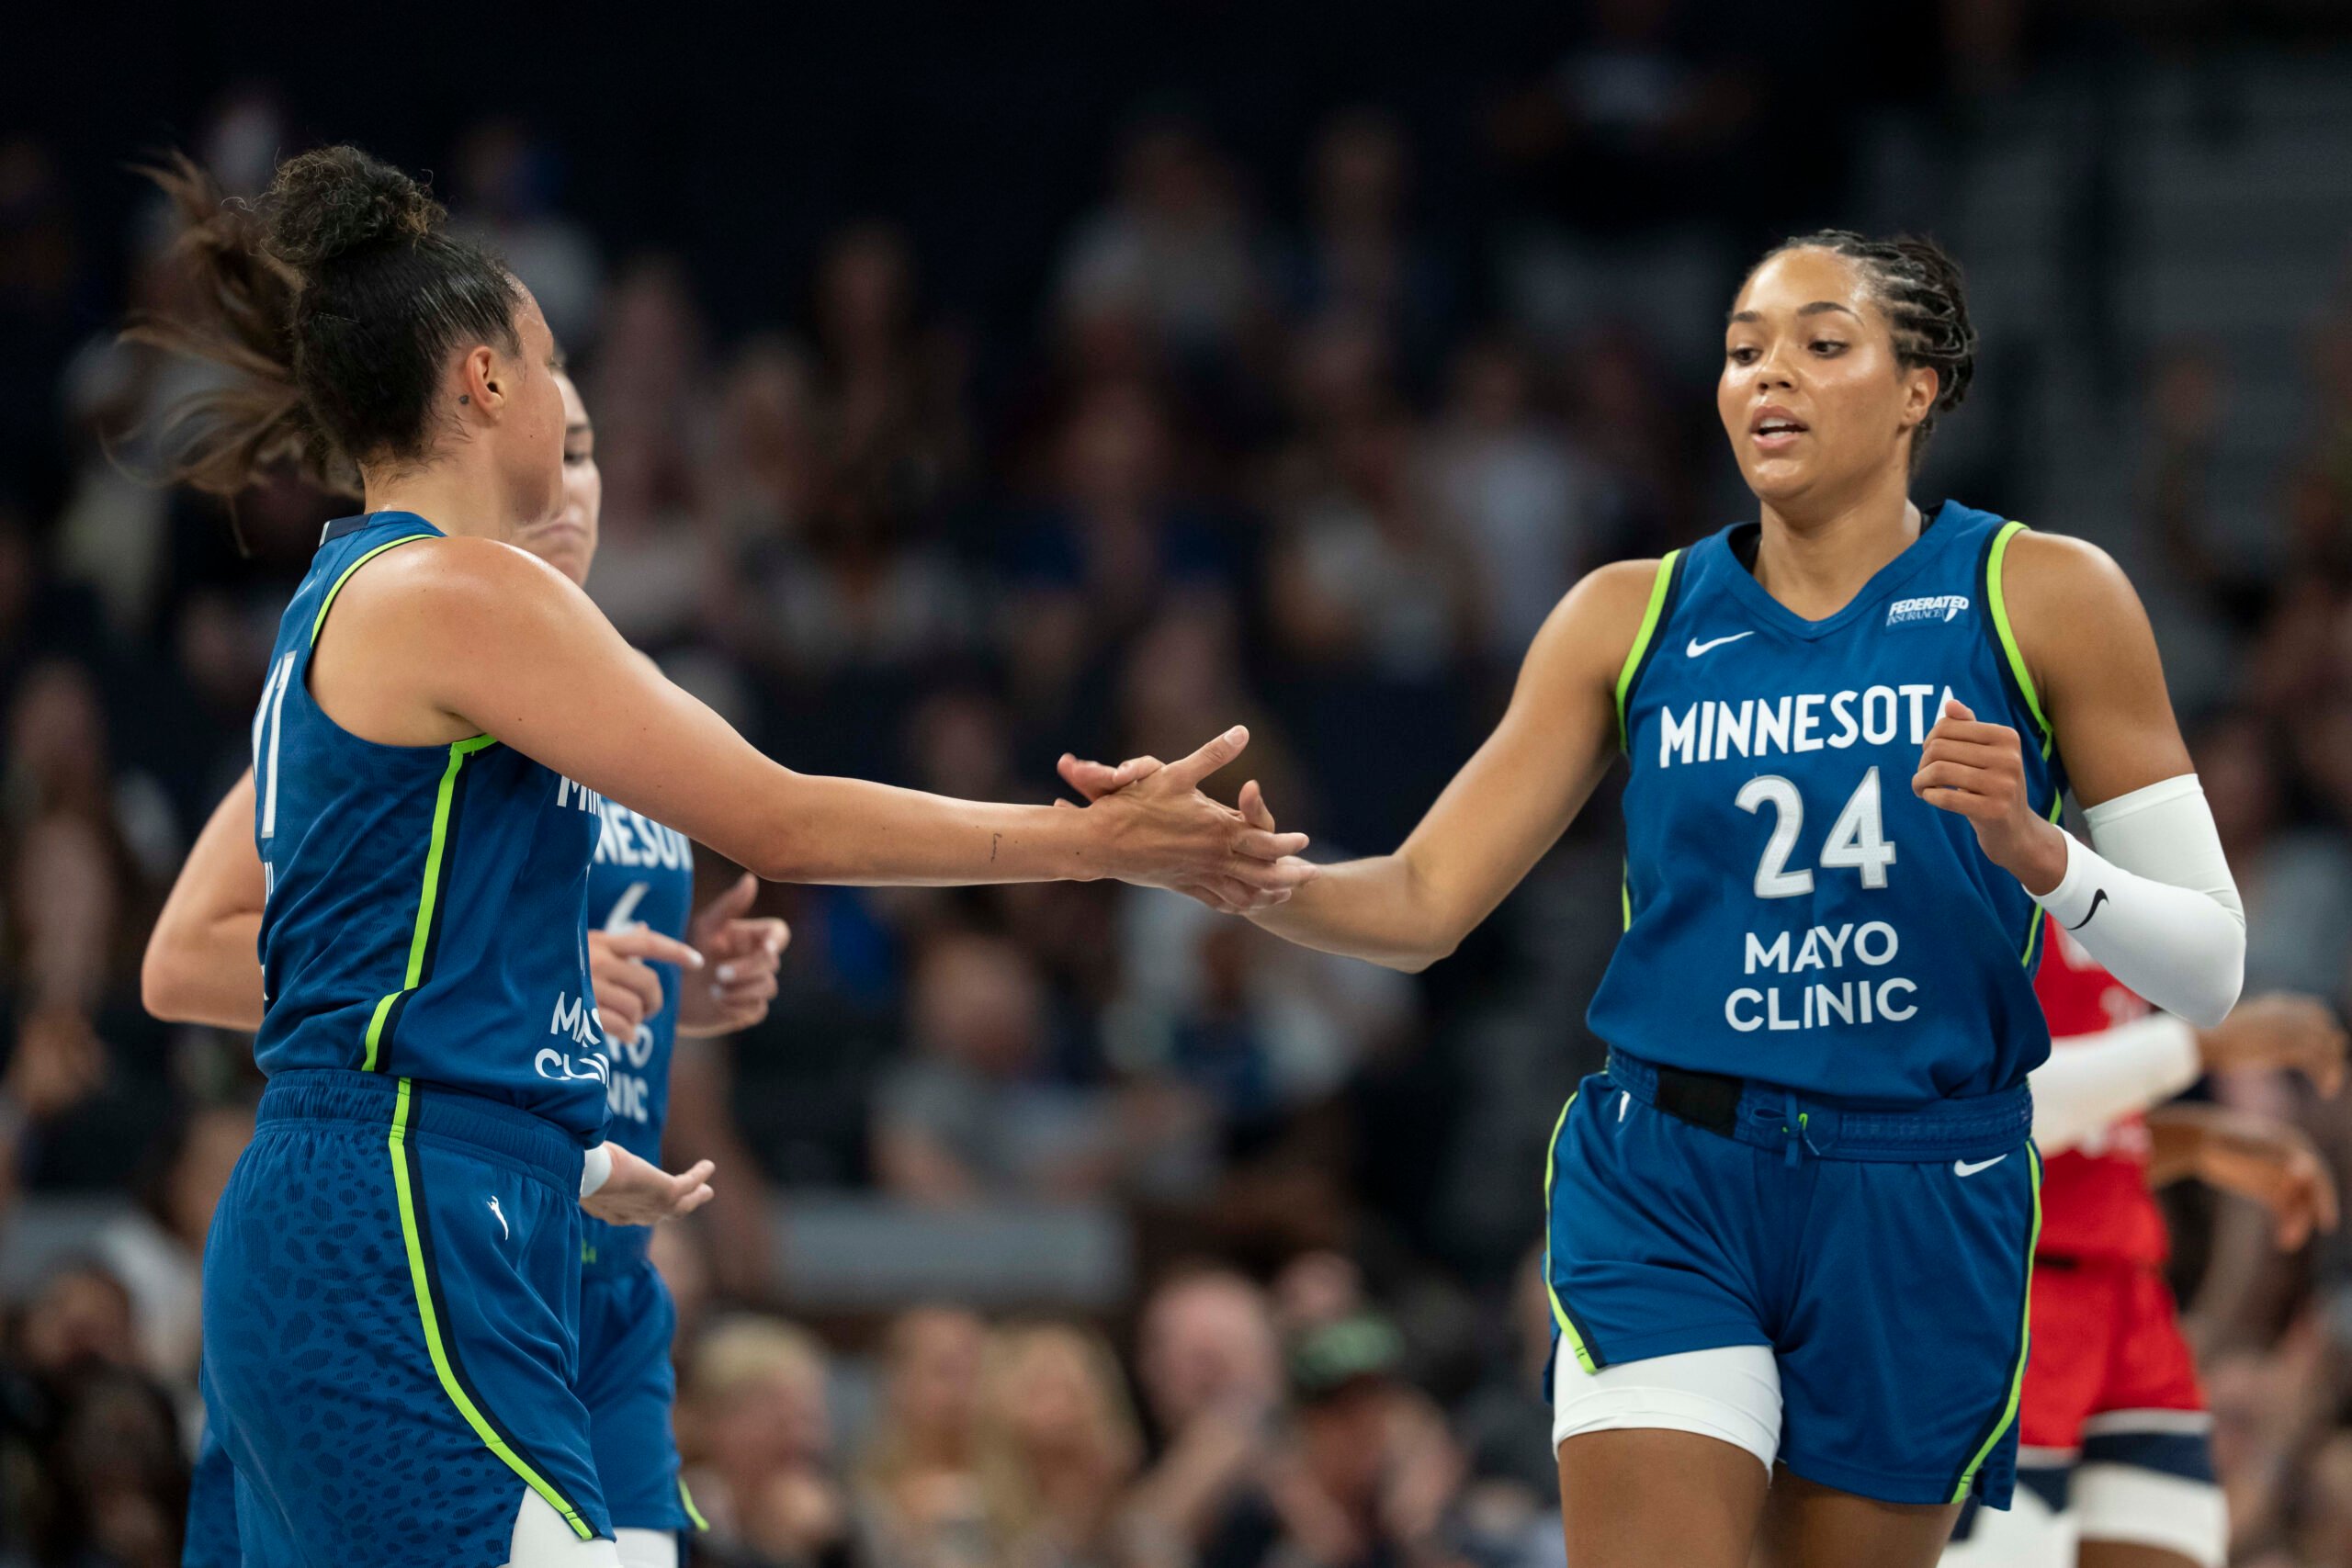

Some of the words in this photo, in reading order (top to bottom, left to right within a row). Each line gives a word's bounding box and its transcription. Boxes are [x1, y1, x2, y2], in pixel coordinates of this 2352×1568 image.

[1889, 595, 1969, 617] FEDERATED
[1735, 765, 1896, 899] 24
[1744, 921, 1898, 974] MAYO
[1725, 977, 1918, 1032] CLINIC
